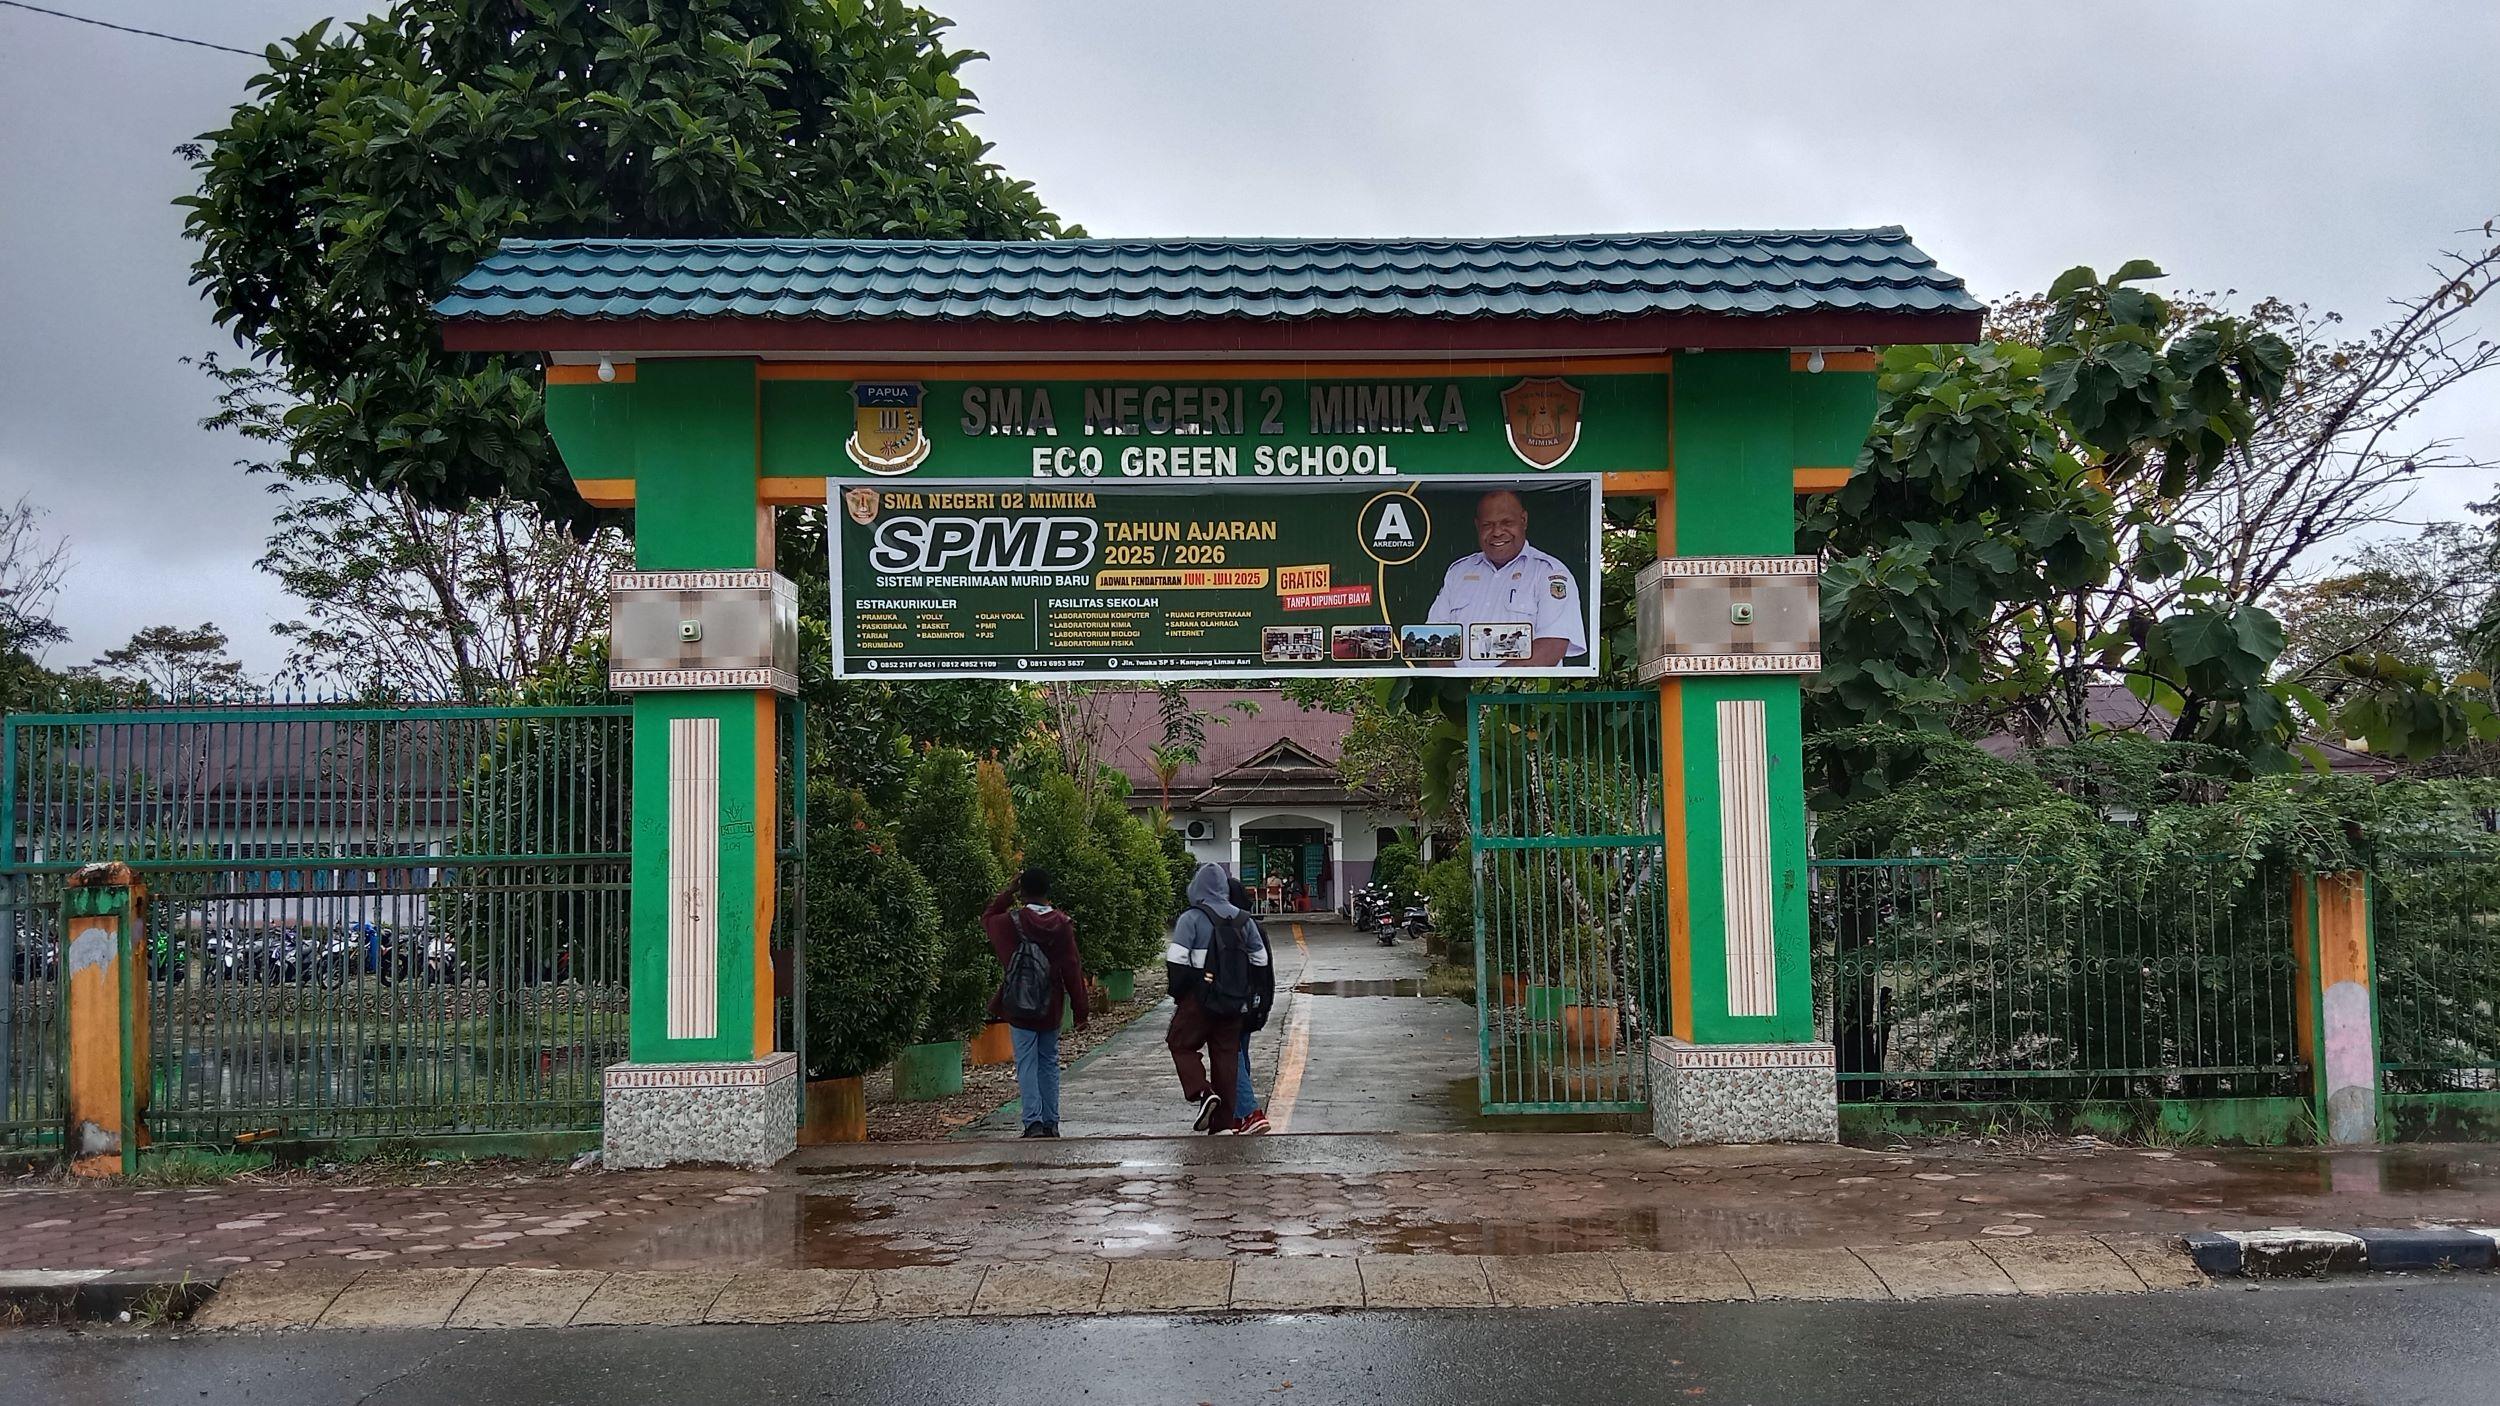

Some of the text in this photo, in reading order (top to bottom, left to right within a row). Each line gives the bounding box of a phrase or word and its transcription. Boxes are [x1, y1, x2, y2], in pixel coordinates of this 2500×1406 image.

[867, 387, 909, 397] PAPUA
[961, 384, 1469, 436] SMA NEGERI 2 MIMIKA
[1527, 438, 1559, 446] MIMIKA
[1032, 444, 1397, 478] ECO GREEN SCHOOL
[884, 493, 1097, 509] SMA NEGERI 02 MIMIKA
[1374, 503, 1413, 540] A
[1103, 521, 1277, 541] TAHUN AJARAN
[872, 518, 1097, 571] SPMB
[1104, 545, 1225, 566] 2025 / 2026
[876, 575, 1090, 587] SISTEM PENERIMAAN MURID BARU
[1100, 576, 1129, 586] JADWAL
[1131, 576, 1182, 586] PENDAFTARAN
[1184, 573, 1205, 585] JUNI
[1212, 573, 1232, 585] JULI
[1234, 572, 1260, 585] 2025
[1280, 570, 1327, 589] GRATIS!
[856, 599, 957, 609] ESTRAKURIKULER
[1048, 598, 1159, 608] FASILITAS SEKOLAH
[1286, 592, 1370, 608] TANPA DIPUNGUT BIAYA
[1180, 659, 1213, 667] Kampung
